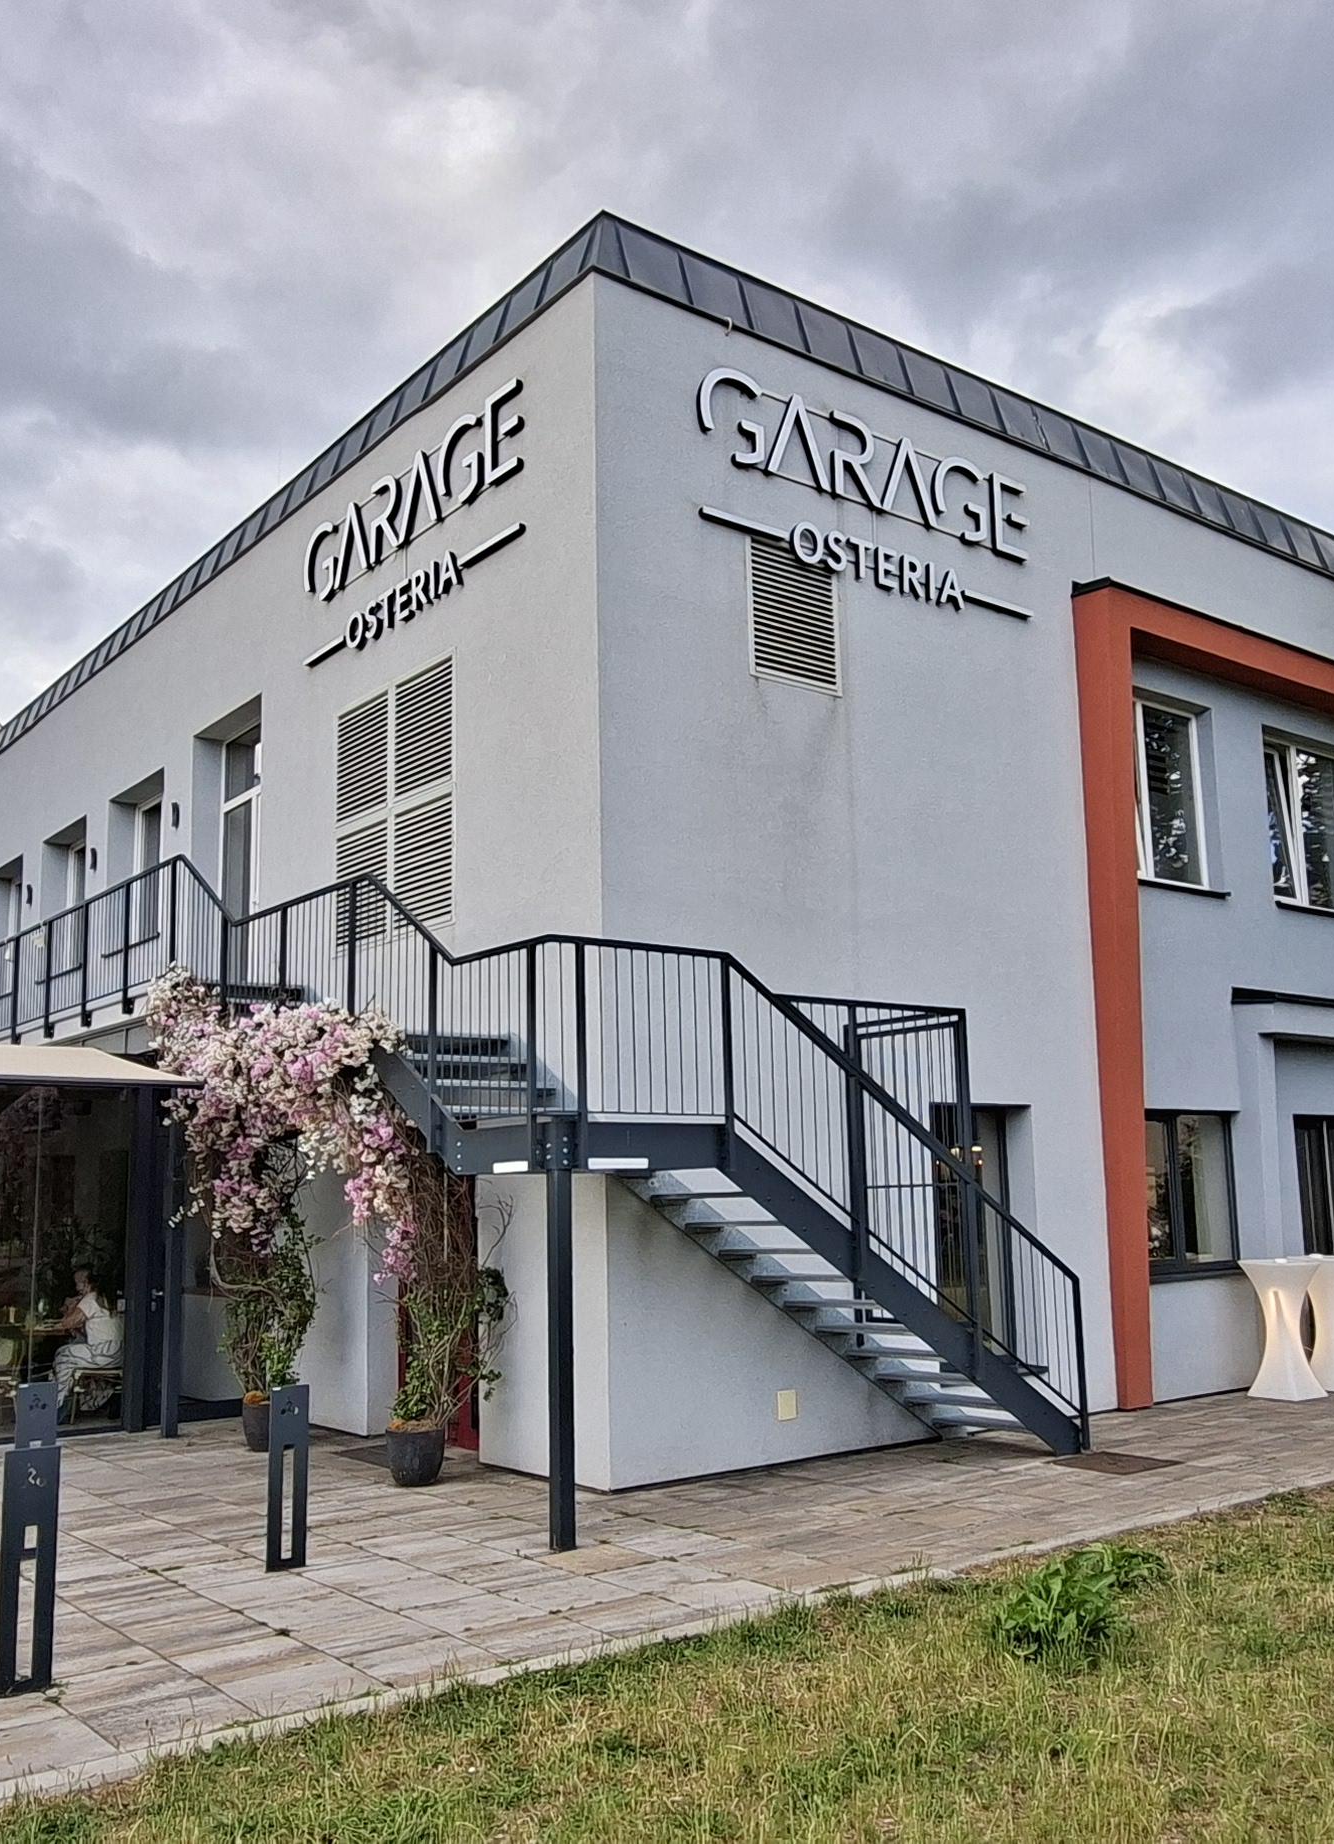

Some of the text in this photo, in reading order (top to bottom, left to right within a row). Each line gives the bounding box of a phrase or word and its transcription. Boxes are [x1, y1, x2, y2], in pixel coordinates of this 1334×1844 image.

[303, 378, 523, 602] GARAGE
[698, 366, 1030, 564] GARAGE
[345, 550, 462, 650] OSTERIA
[789, 520, 965, 611] OSTERIA
